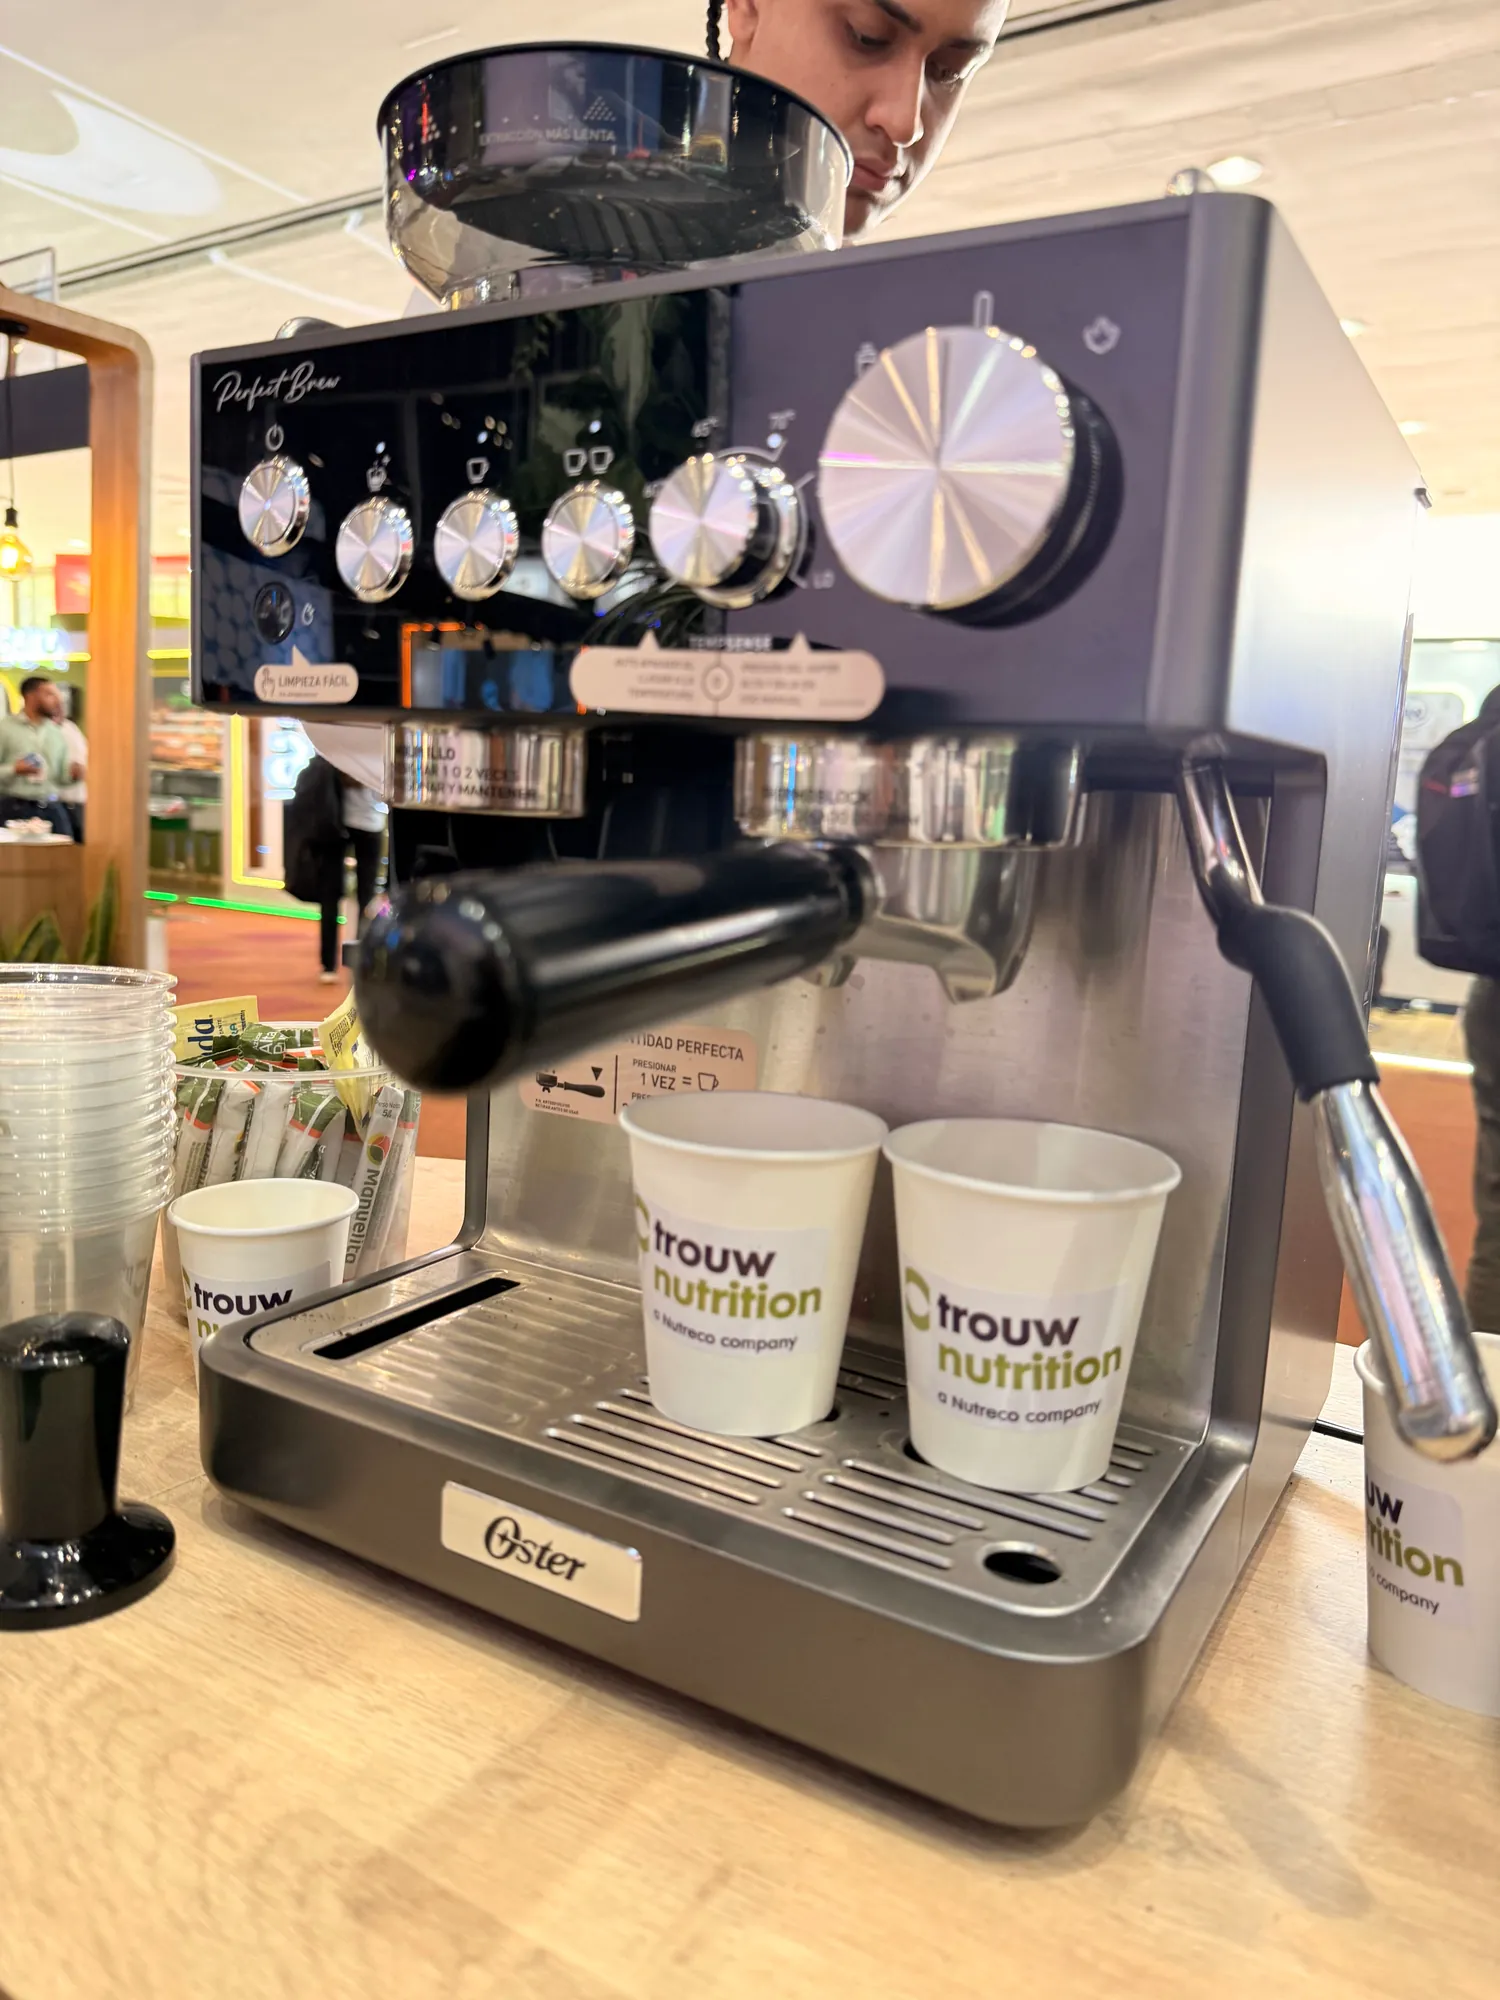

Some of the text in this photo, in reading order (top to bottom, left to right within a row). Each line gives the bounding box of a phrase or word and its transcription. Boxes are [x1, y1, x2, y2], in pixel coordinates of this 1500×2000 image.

[573, 128, 616, 142] LENTA
[213, 360, 341, 412] Perfect Brew
[278, 673, 350, 688] LIMPIEZA FÁCIL
[632, 1058, 677, 1073] PRESIONAR
[676, 1038, 744, 1062] PERFECTA
[641, 1072, 676, 1091] 1 VEZ
[345, 1168, 380, 1264] Manuelita
[653, 1219, 777, 1278] trouw
[194, 1282, 293, 1315] trouw
[653, 1265, 822, 1319] nutrition
[662, 1314, 716, 1345] Nutreco
[720, 1336, 798, 1353] company
[937, 1293, 1080, 1347] trouw
[938, 1343, 1122, 1390] nutrition
[937, 1391, 1102, 1424] a Nutreco company
[484, 1516, 586, 1581] Oster
[1367, 1517, 1464, 1587] rition
[1376, 1573, 1440, 1615] company
